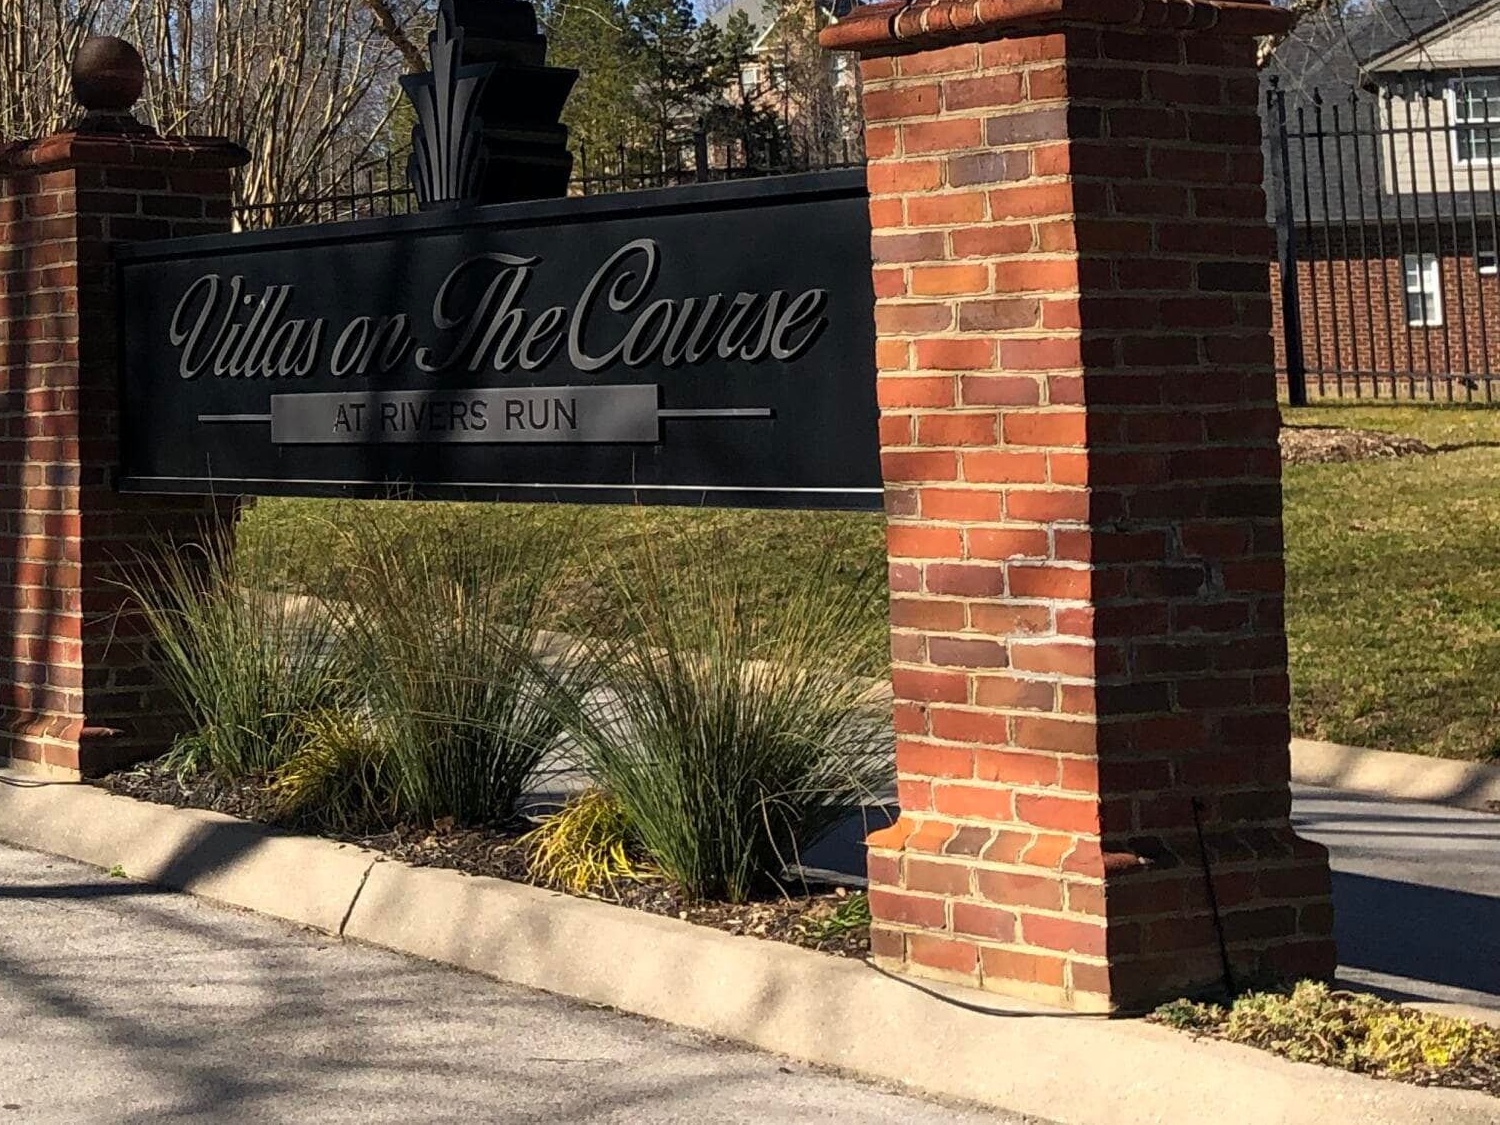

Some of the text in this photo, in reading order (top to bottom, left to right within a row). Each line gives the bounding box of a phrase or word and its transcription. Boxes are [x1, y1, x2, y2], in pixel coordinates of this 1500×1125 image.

[170, 237, 827, 378] Villas on The Course
[334, 397, 579, 433] AT RIVERS RUN
